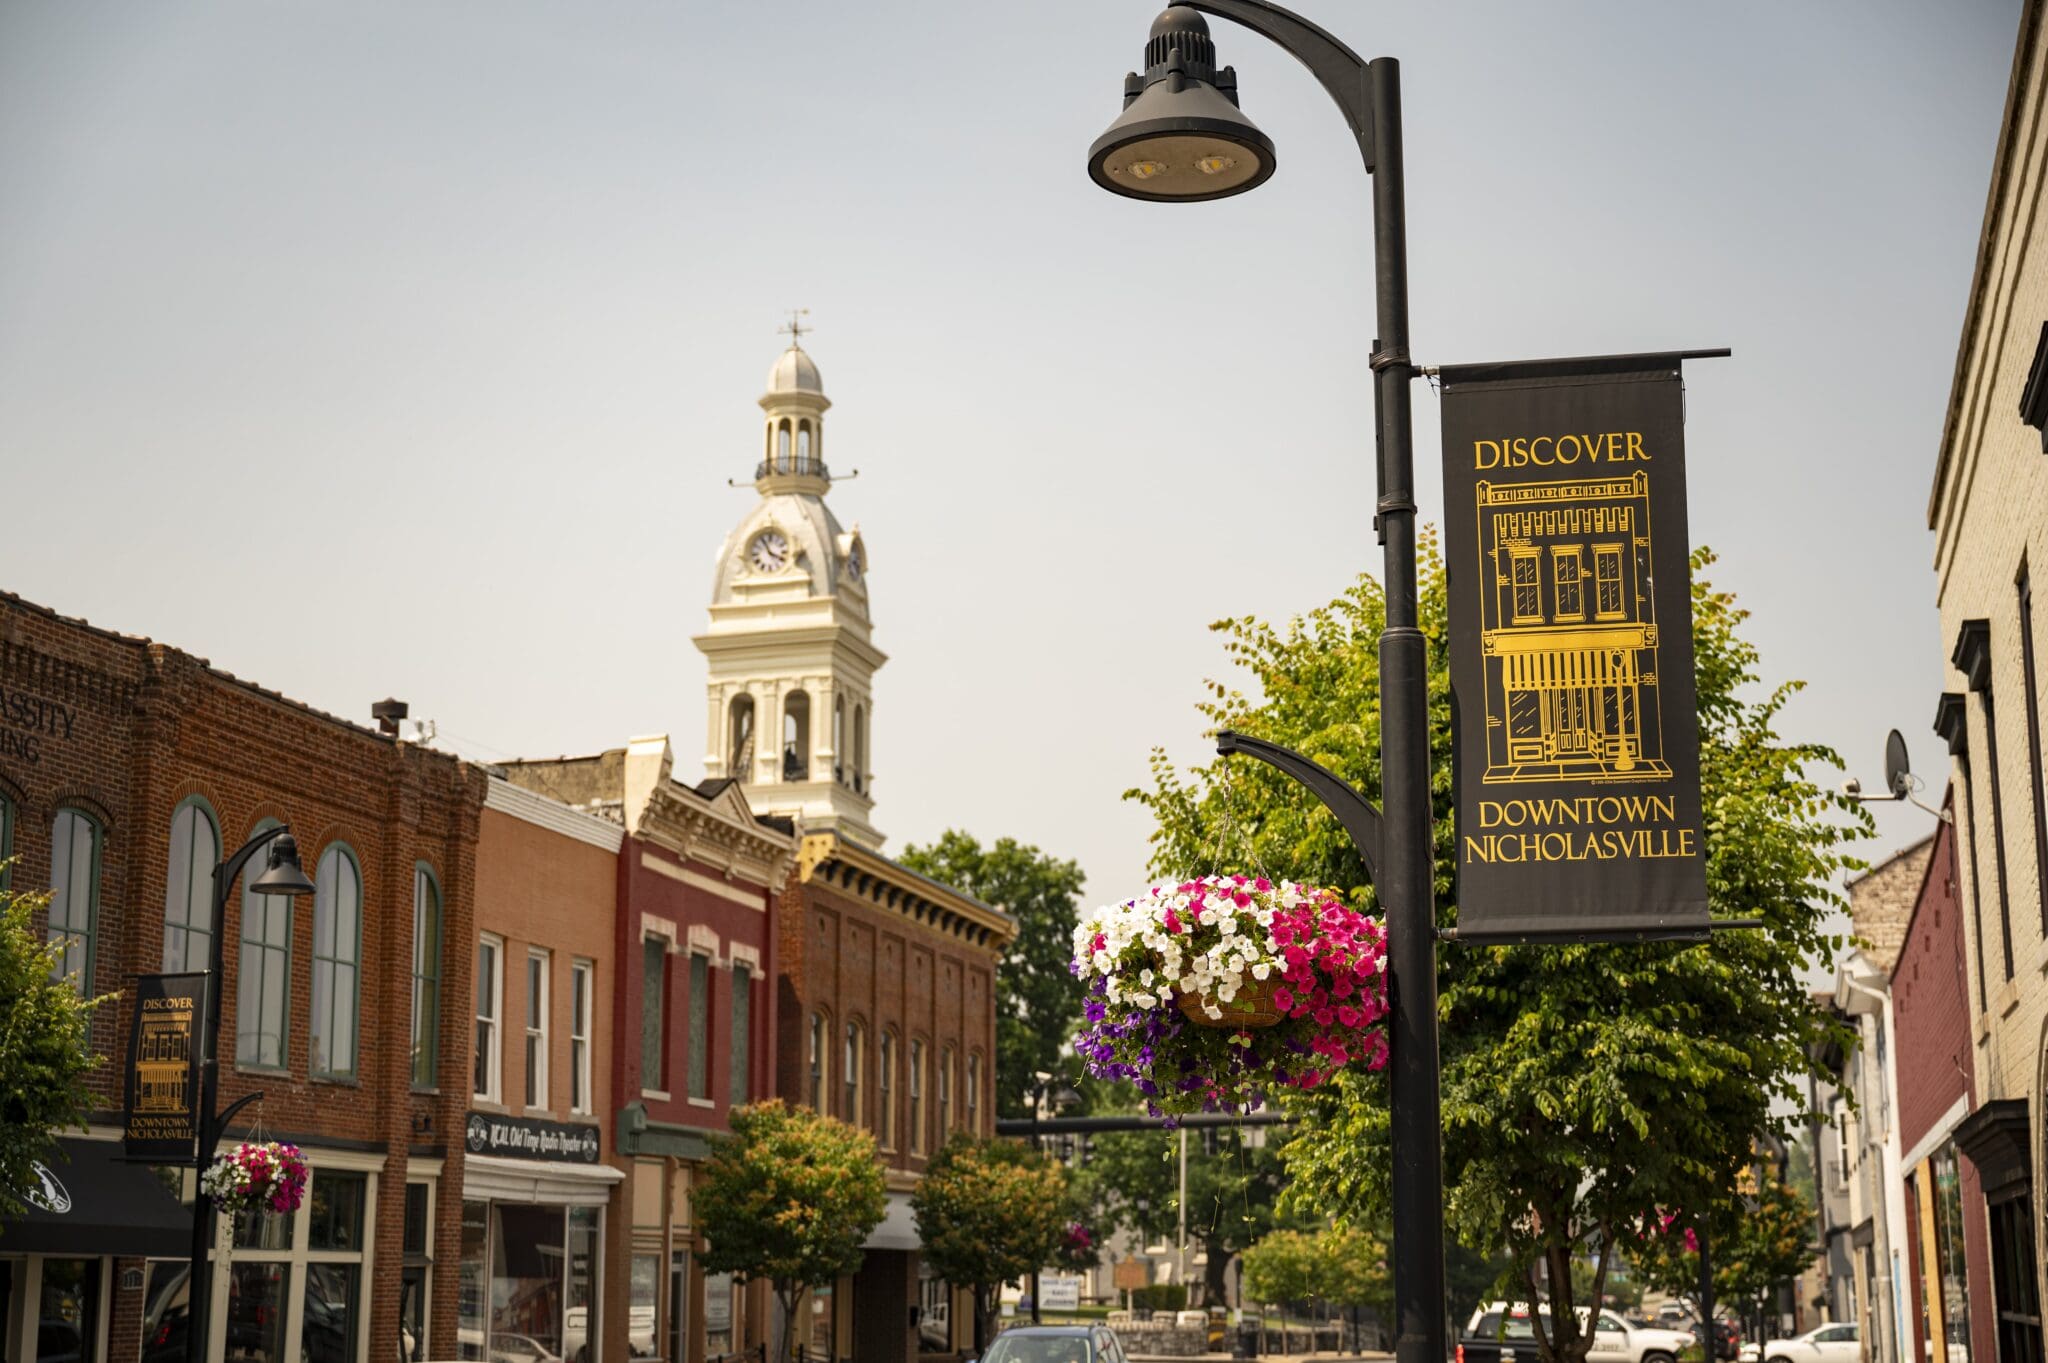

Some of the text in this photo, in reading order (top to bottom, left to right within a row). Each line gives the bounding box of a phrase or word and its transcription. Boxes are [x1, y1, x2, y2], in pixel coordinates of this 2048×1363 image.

[1473, 432, 1652, 469] DISCOVER
[1478, 796, 1676, 828] DOWNTOWN
[1464, 829, 1697, 863] NICHOLASVILLE
[143, 997, 194, 1010] DISCOVER
[127, 1128, 194, 1140] NICHOLASVILLE
[131, 1117, 190, 1128] DOWNTOWN
[510, 1126, 522, 1147] Old
[540, 1130, 558, 1153] Radio
[559, 1131, 582, 1155] Theater
